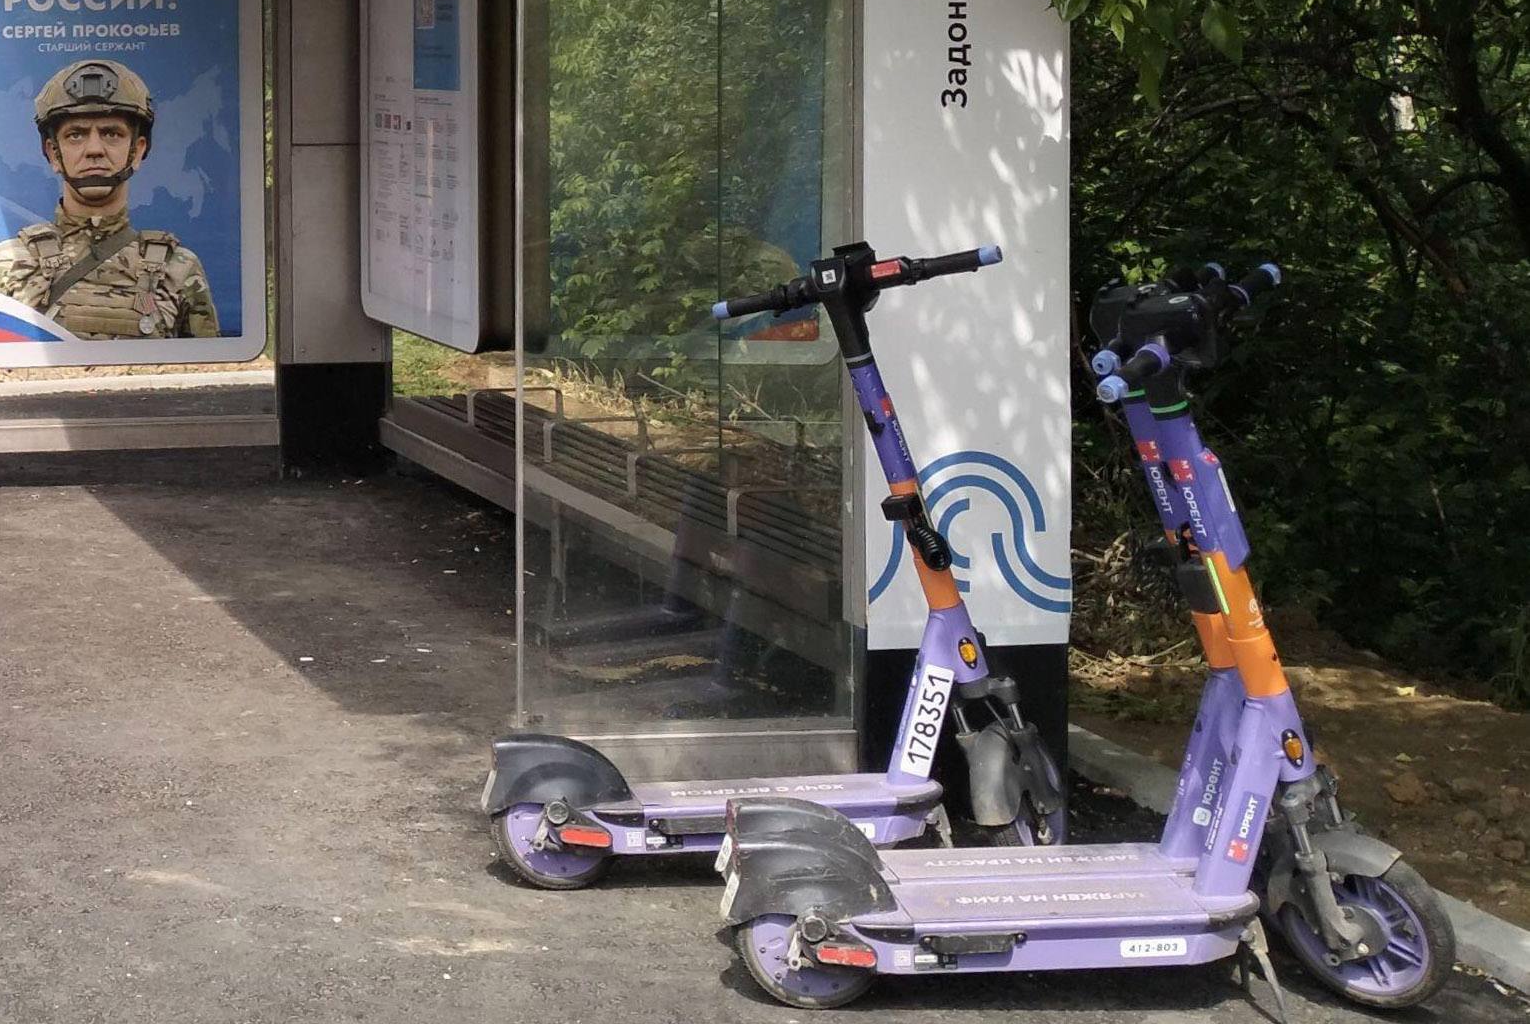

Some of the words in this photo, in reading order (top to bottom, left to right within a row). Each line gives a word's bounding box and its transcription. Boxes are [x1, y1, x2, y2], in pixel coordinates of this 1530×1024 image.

[2, 21, 66, 39] СЕРГЕЙ
[72, 24, 180, 38] ПРОКОФЬЕВ
[38, 41, 91, 52] СТАРШИЙ
[95, 41, 146, 52] СЕРЖАНТ
[1149, 466, 1173, 515] ЮРЕНТ
[1182, 486, 1208, 537] ЮРЕНТ
[907, 674, 950, 764] 178351
[1237, 794, 1259, 839] ЮРЕНТ
[1018, 894, 1047, 904] НА
[1129, 943, 1178, 953] 412-803
